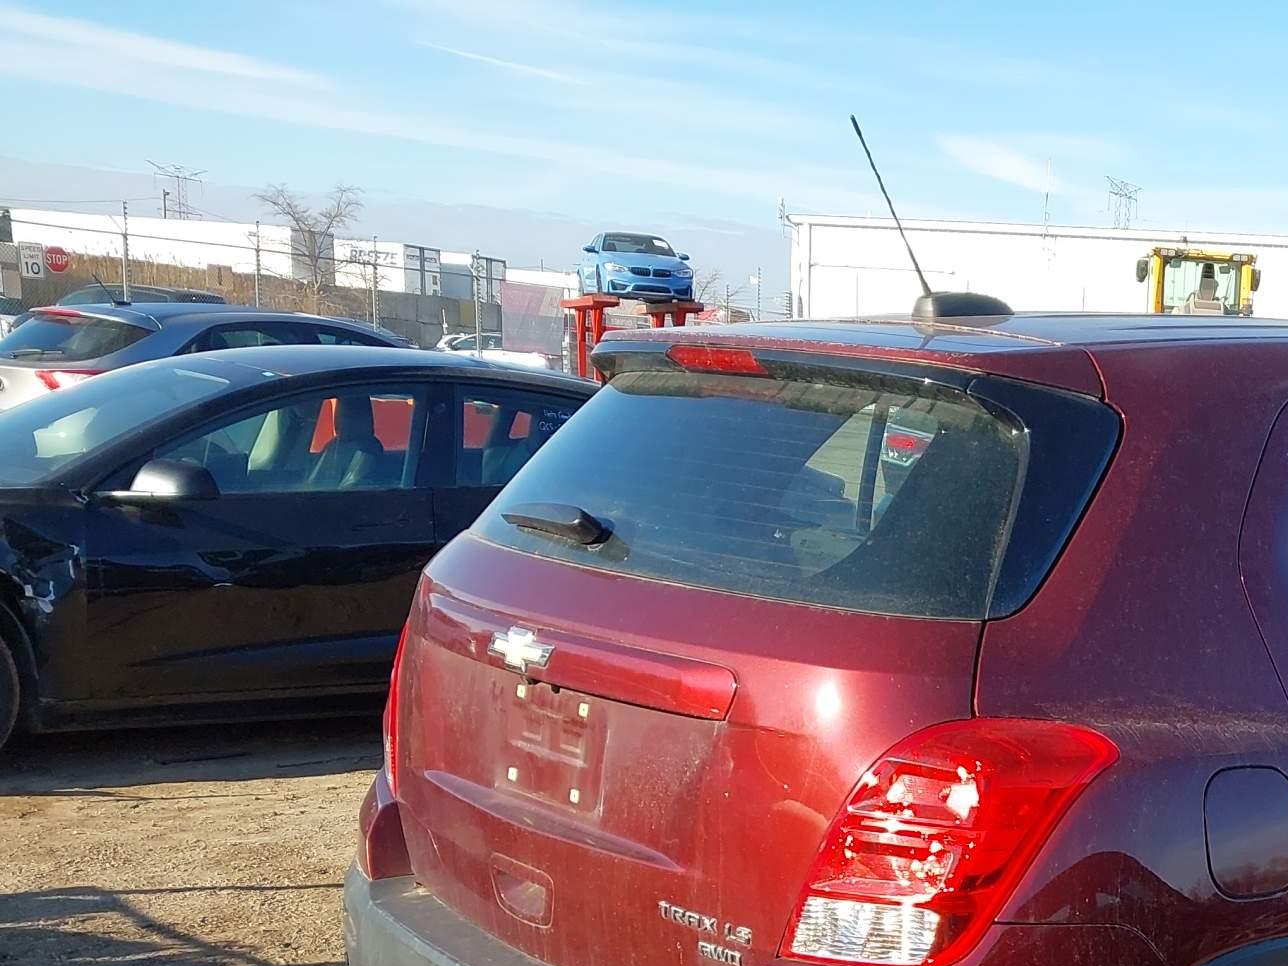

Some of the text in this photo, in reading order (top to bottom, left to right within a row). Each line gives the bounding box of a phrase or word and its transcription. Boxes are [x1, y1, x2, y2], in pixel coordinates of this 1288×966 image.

[46, 253, 67, 265] STOP
[24, 261, 40, 275] 10
[657, 900, 753, 947] TRAX LS
